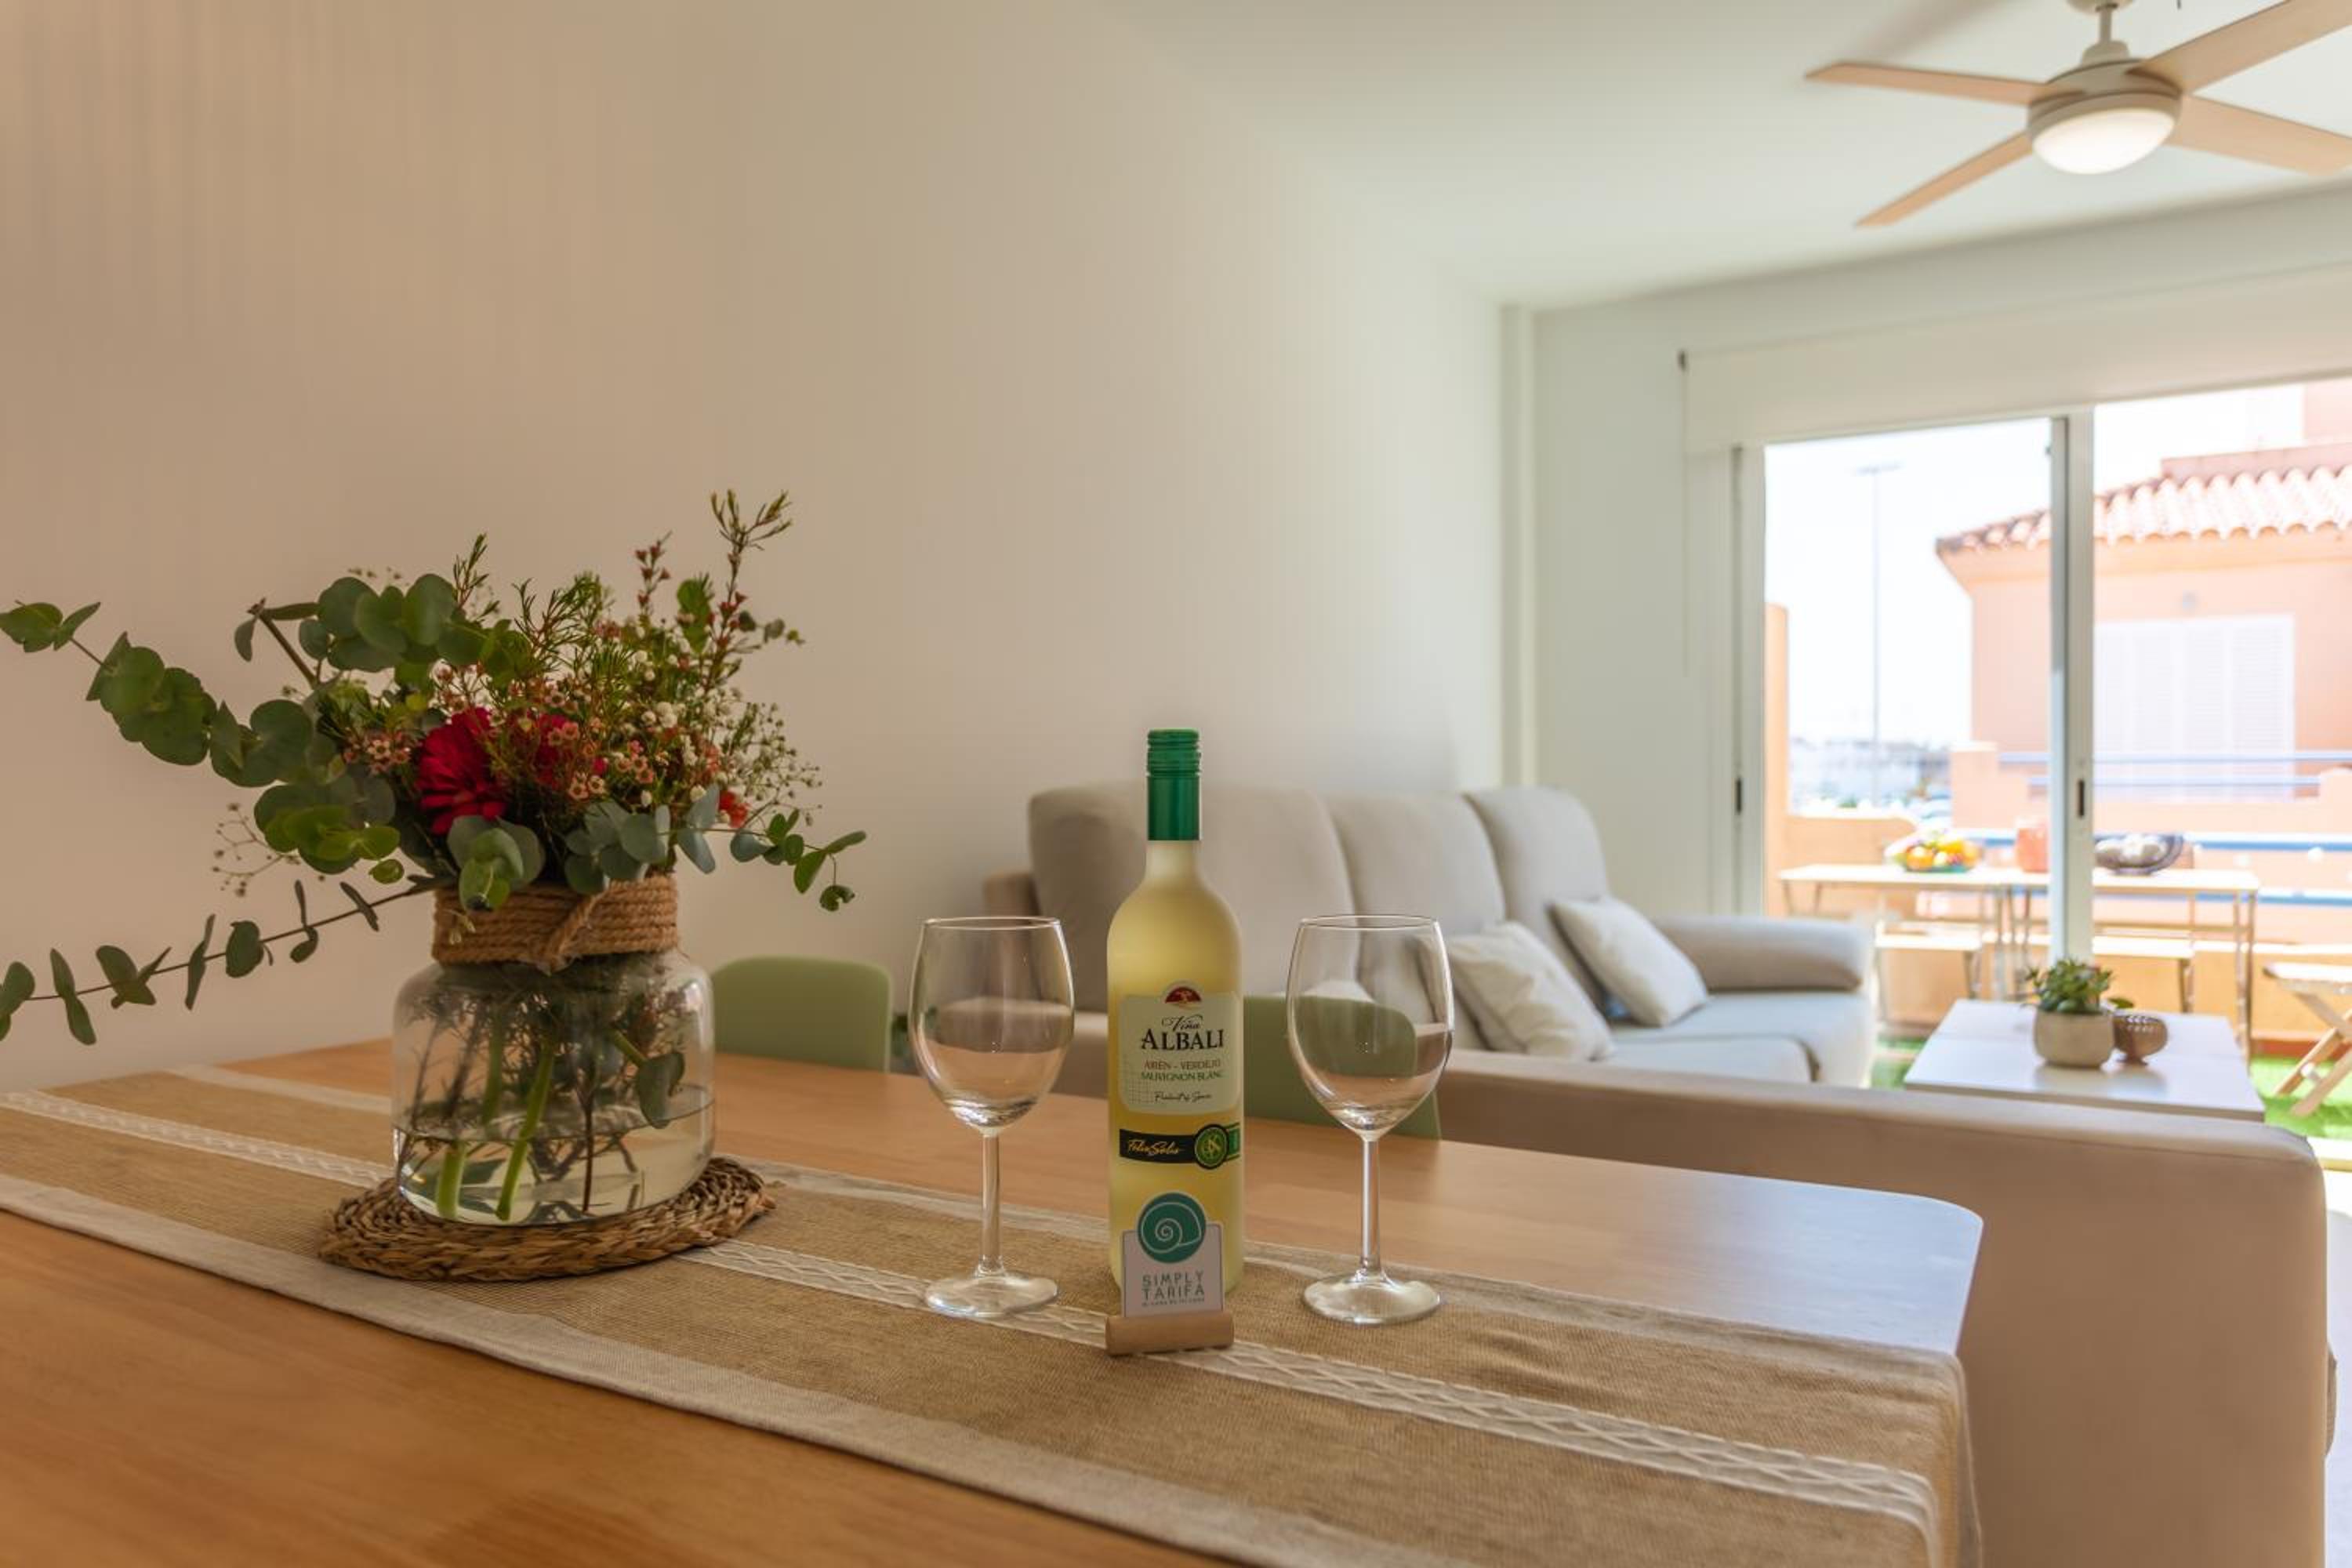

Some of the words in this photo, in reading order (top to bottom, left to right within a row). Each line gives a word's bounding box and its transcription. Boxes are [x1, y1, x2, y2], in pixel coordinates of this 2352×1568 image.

[1141, 1028, 1224, 1050] ALBALI
[1142, 1269, 1204, 1287] SIMPLY
[1142, 1283, 1205, 1301] TARIFA
